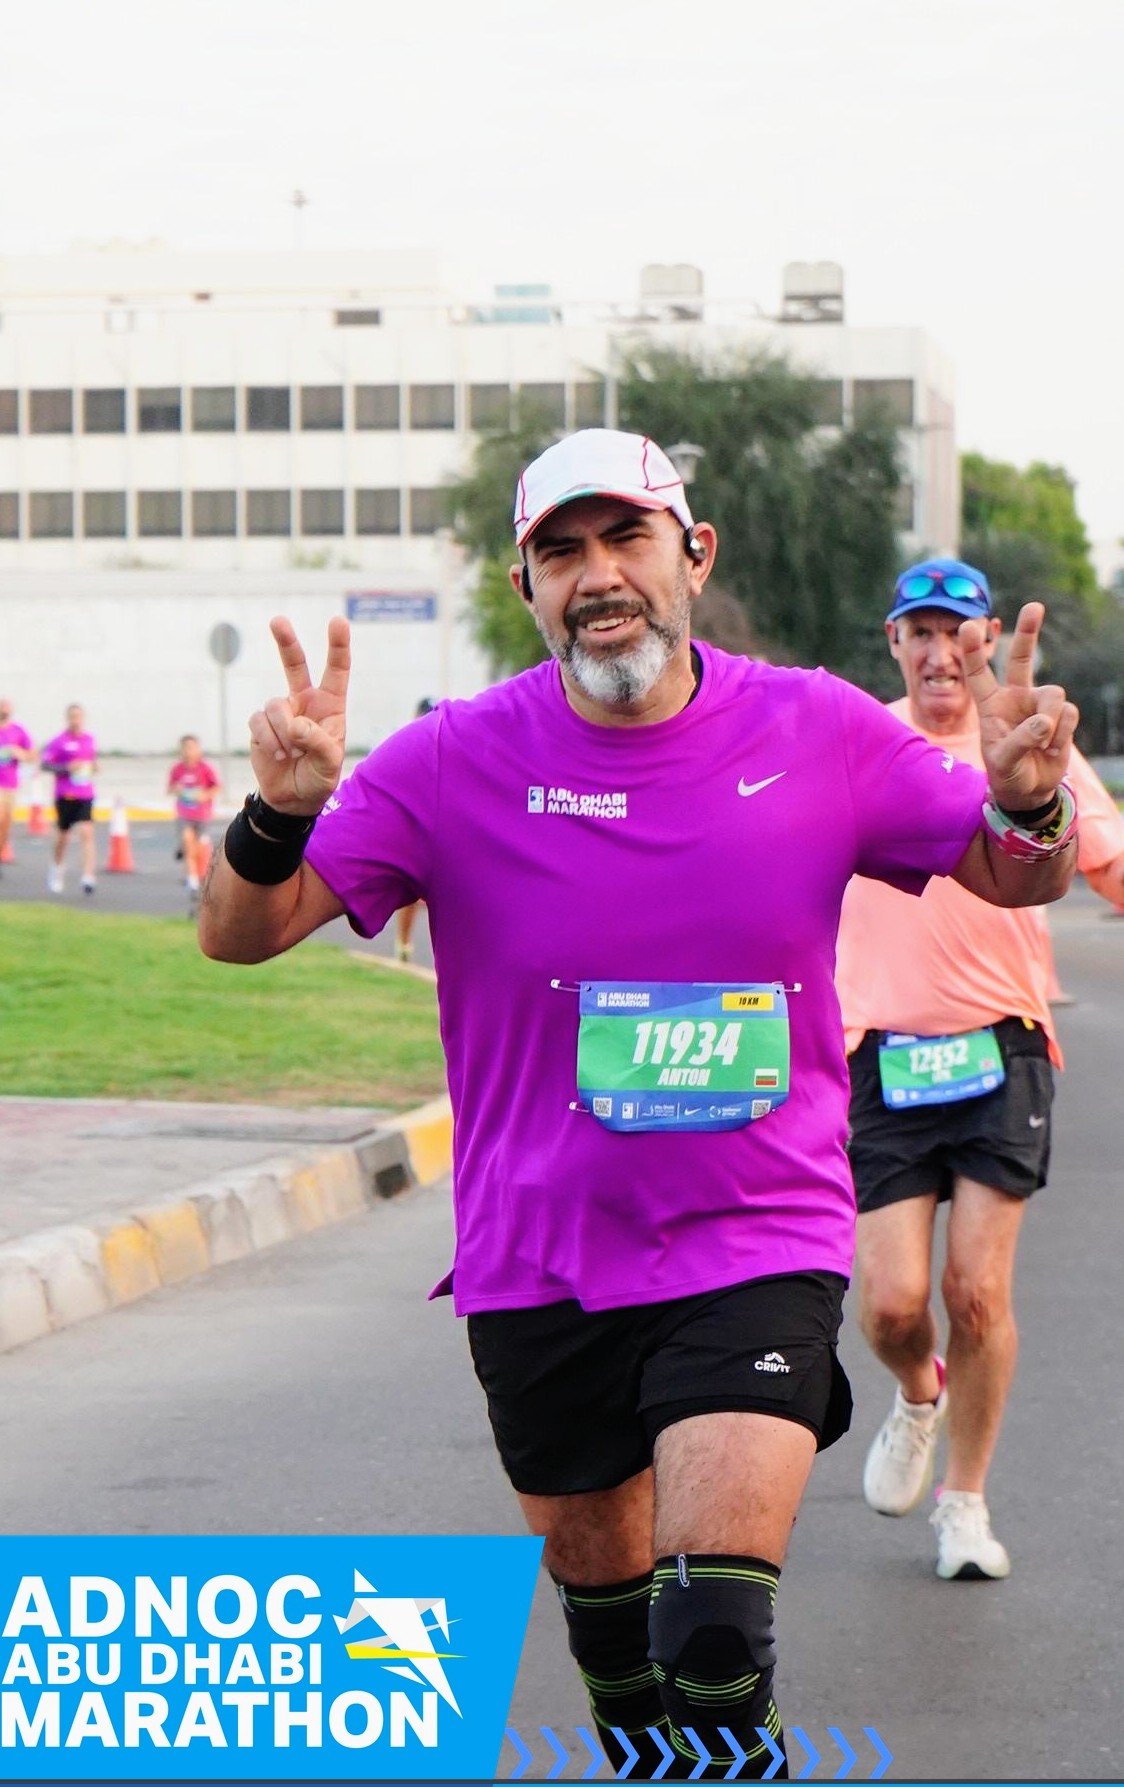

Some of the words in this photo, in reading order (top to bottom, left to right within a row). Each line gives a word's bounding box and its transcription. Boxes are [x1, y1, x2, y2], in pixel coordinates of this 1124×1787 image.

[547, 787, 578, 803] ABU
[579, 792, 627, 807] DHABI
[547, 801, 627, 819] MARATHON
[608, 992, 625, 1000] ABU
[625, 992, 650, 1000] DHABI
[608, 999, 650, 1007] MARATHON
[738, 997, 747, 1006] 10
[747, 997, 759, 1006] KM
[632, 1021, 742, 1066] 11934
[657, 1067, 711, 1087] ANTON
[754, 1360, 791, 1374] CRIVIT
